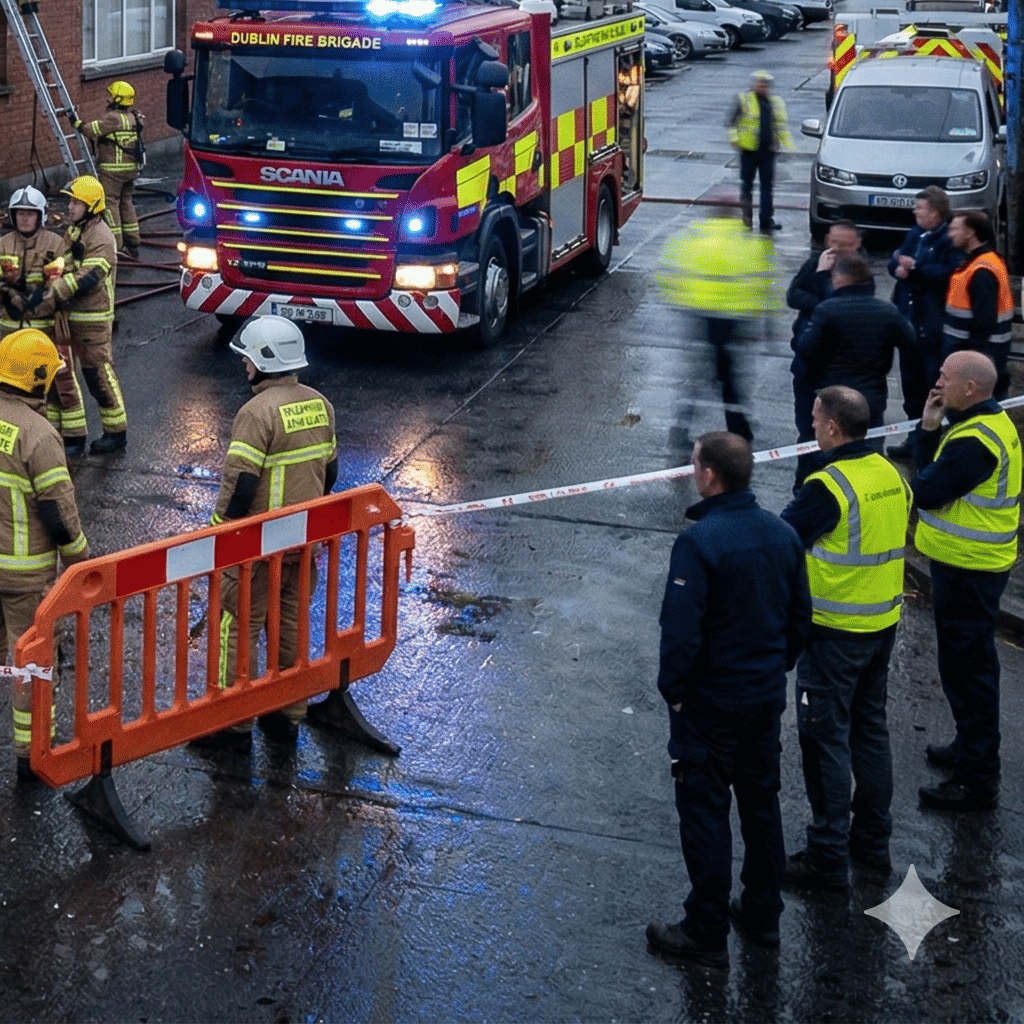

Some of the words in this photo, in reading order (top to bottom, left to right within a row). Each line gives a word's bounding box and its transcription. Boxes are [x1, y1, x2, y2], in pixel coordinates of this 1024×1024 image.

[231, 32, 280, 45] DUBLIN
[283, 34, 314, 47] FIRE
[317, 35, 382, 50] BRIGADE
[259, 166, 345, 187] SCANIA
